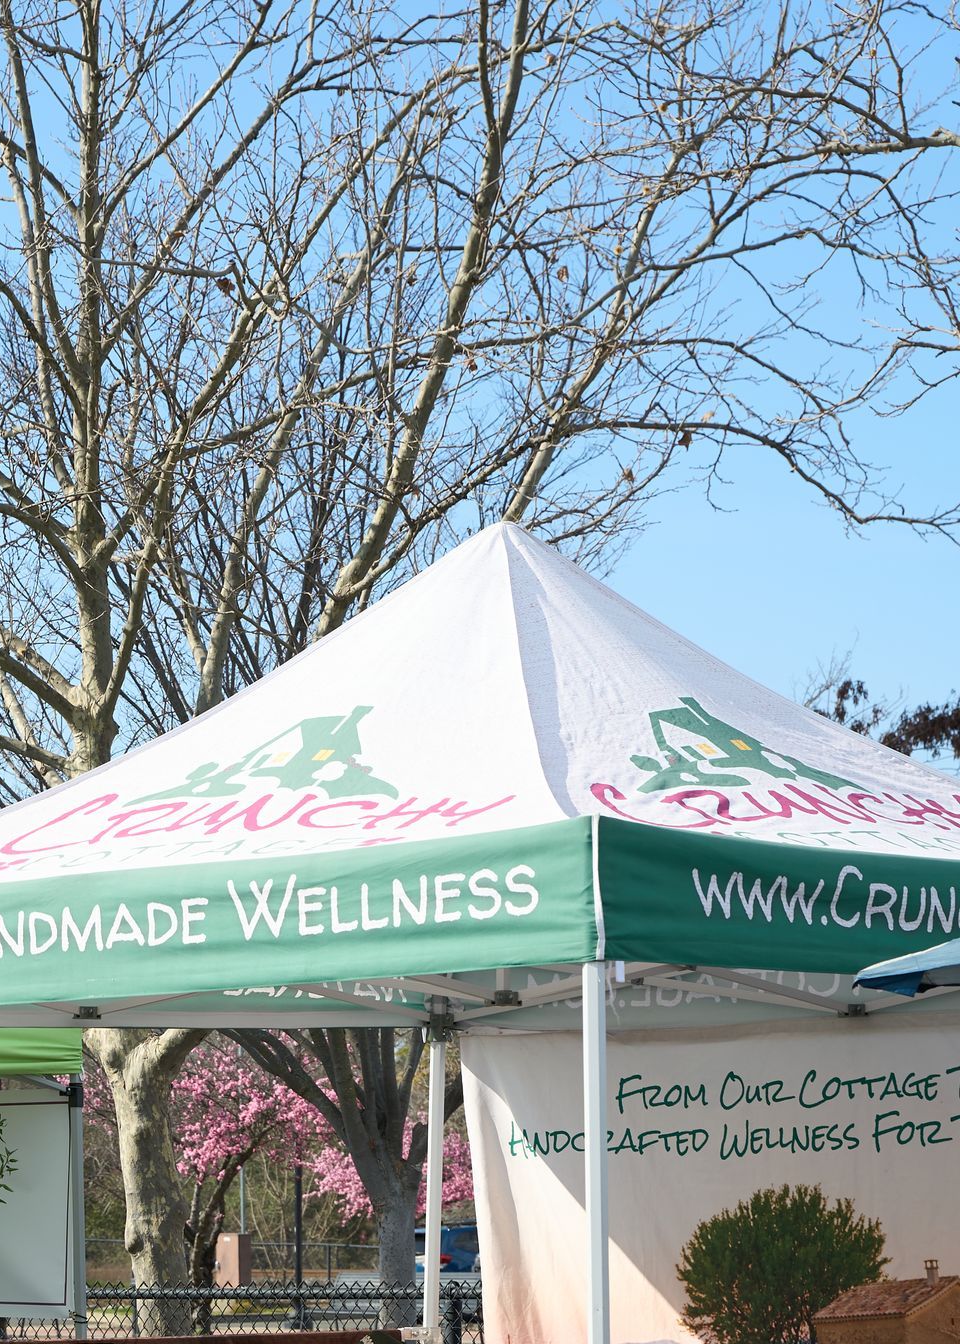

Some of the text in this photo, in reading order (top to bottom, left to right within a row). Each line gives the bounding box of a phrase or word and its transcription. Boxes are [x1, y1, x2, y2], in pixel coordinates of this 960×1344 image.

[1, 793, 516, 856] CRUNCHY
[226, 863, 539, 940] WELLNESS
[691, 865, 960, 934] WWW.CRUN
[615, 1073, 708, 1113] FROM
[719, 1070, 795, 1110] OUR
[799, 1069, 941, 1108] COTTAGE
[720, 1119, 859, 1160] WELLNESS
[872, 1110, 953, 1152] FOR
